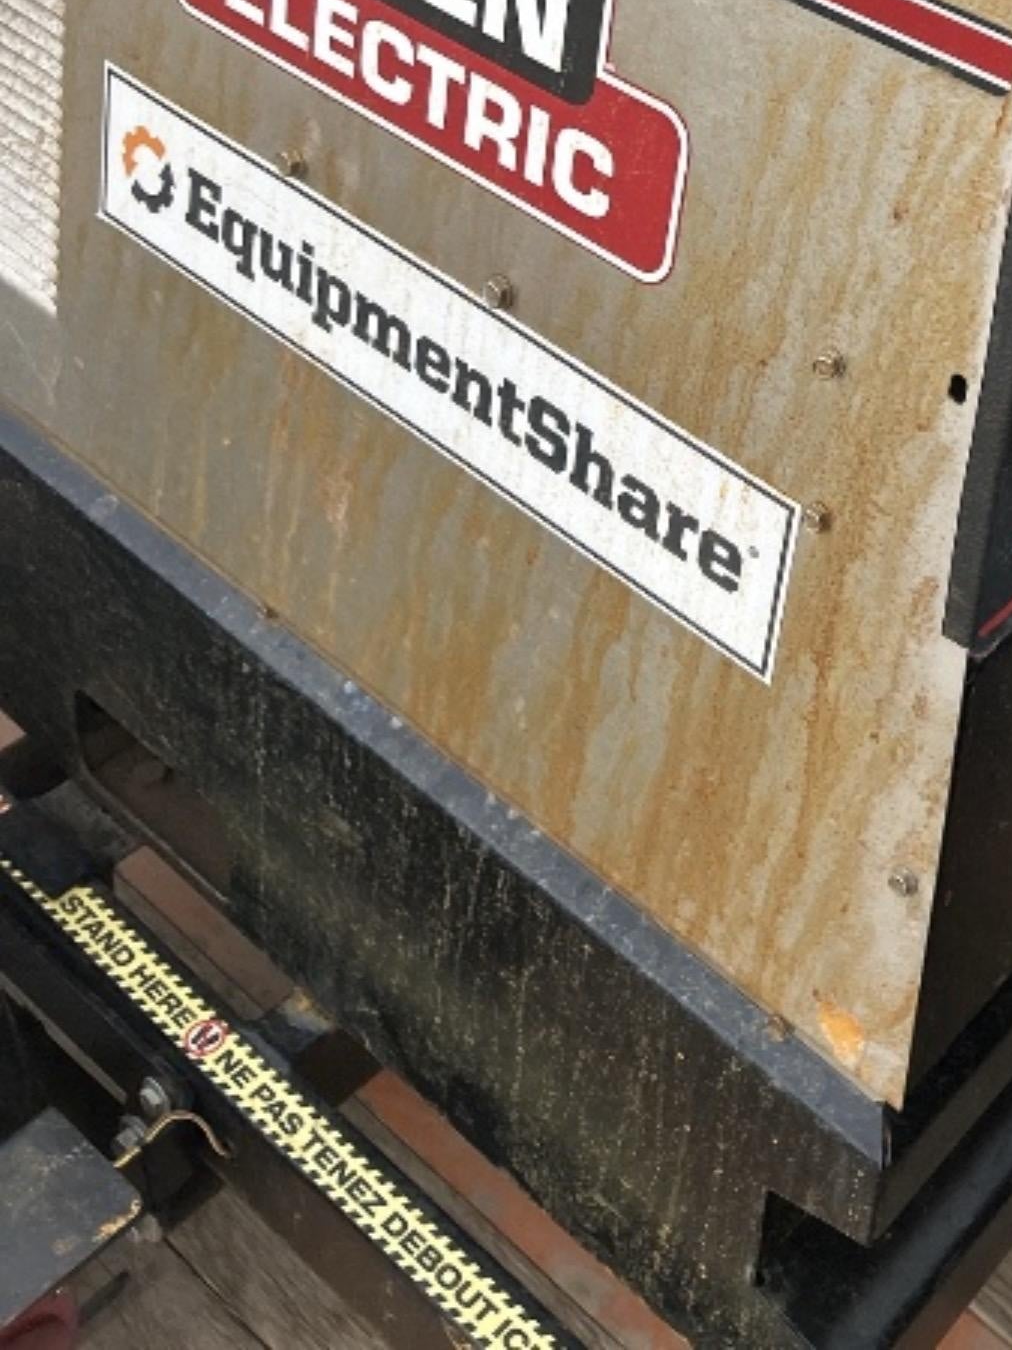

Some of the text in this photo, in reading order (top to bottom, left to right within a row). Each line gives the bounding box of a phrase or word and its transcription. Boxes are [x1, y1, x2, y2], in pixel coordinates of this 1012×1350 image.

[184, 166, 744, 594] EquipmentShare
[60, 896, 543, 1350] STAND HERE NE PAS TENEZ DEBOUT IC
